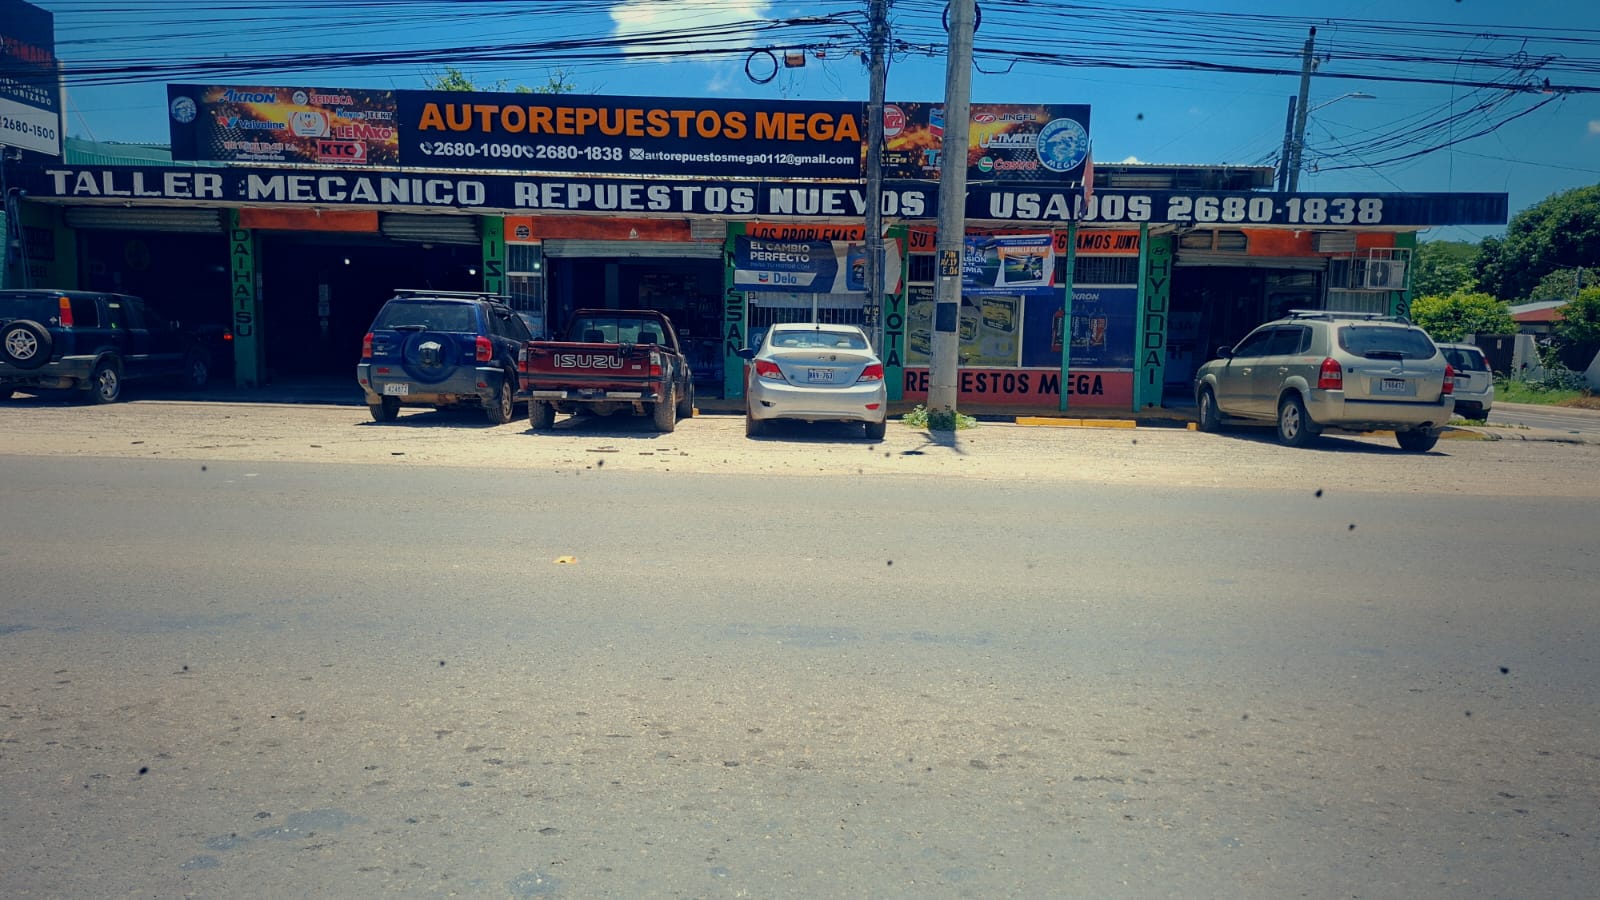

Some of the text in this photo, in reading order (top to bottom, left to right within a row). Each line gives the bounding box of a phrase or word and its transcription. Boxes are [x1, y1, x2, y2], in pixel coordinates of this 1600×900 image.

[219, 88, 275, 103] AKRON
[4, 117, 55, 140] 2680-1500
[239, 119, 285, 130] Valvoline
[418, 103, 747, 139] AUTOREPUESTOS
[755, 112, 861, 141] MEGA
[980, 133, 1037, 148] ULTIMATE
[321, 143, 354, 155] KTC
[434, 142, 854, 165] 2680-1090 2680-1838 autorepuestosmega0112@gmail.com
[994, 159, 1038, 171] Castrol
[1047, 159, 1078, 169] MEGA
[46, 170, 1383, 224] TALLER MECANICO REPUESTOS NUEVOS USADOS 2680-1838
[750, 241, 810, 253] EL CAMBIO
[750, 251, 810, 263] PERFECTO
[773, 272, 797, 285] Delo
[1144, 259, 1168, 384] HYUNDAI
[554, 353, 624, 369] ISUZU
[905, 371, 1104, 396] REESTOS MEGA
